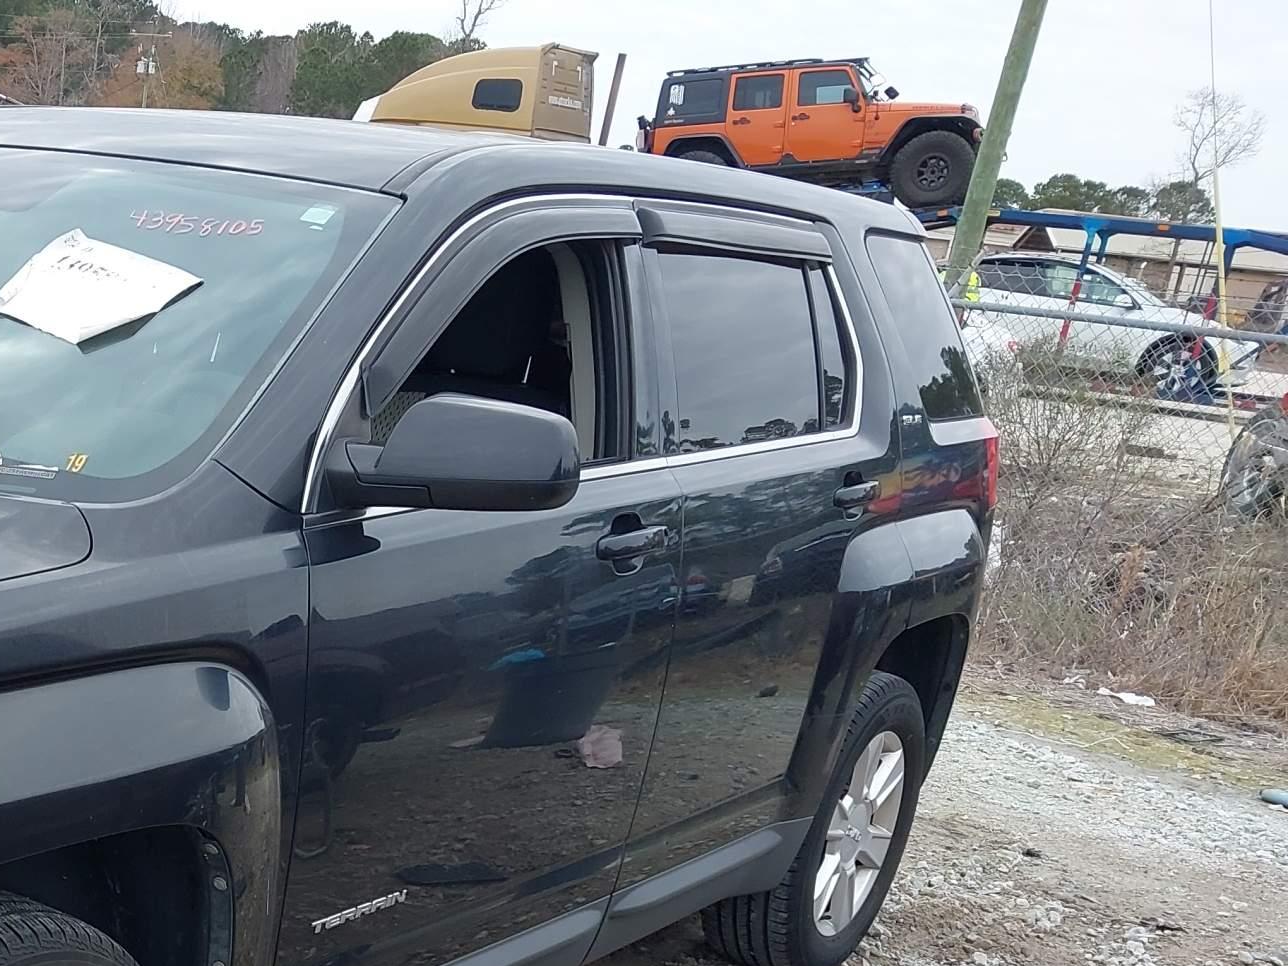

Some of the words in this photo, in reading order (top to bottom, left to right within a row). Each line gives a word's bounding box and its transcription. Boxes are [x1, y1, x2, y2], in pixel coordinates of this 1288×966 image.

[129, 207, 265, 237] 43958105
[65, 453, 89, 472] 19
[311, 889, 408, 934] TERRAIN
